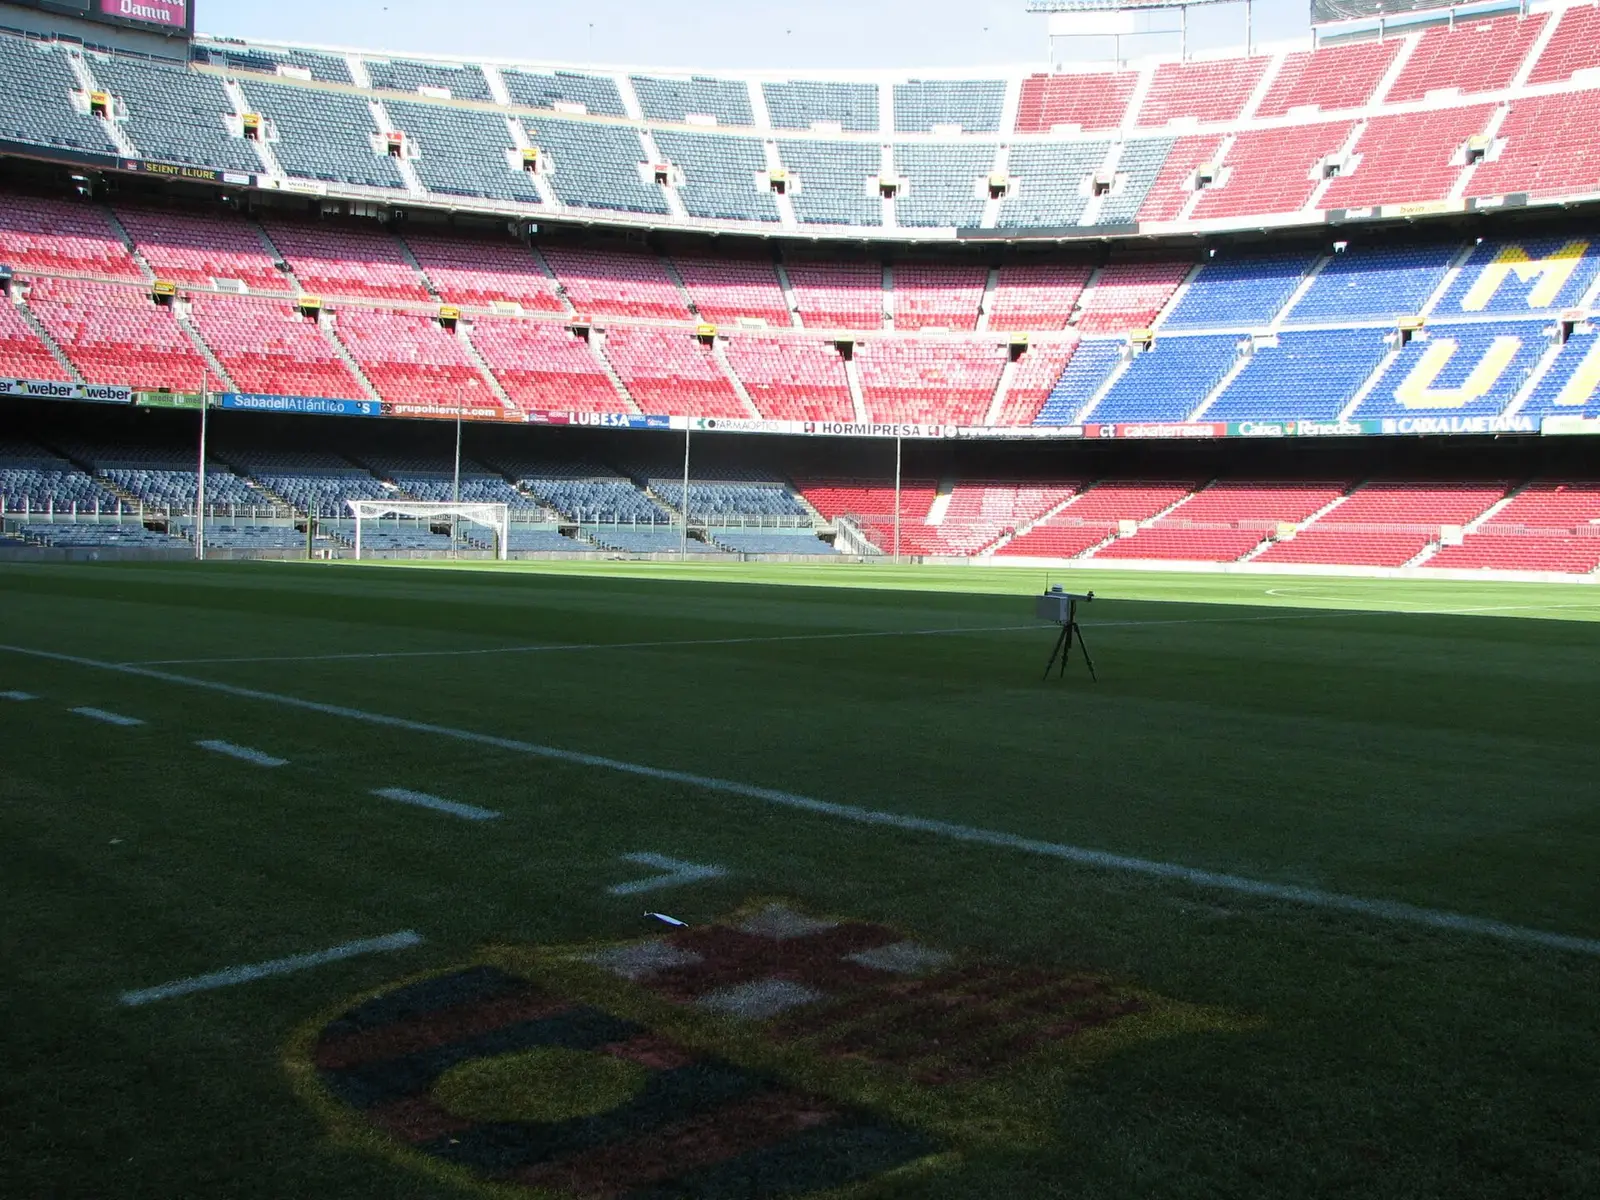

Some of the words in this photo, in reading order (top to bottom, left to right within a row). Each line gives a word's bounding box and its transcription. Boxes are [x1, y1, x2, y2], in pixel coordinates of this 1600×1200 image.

[120, 0, 171, 21] Damm
[28, 383, 73, 396] weber
[86, 386, 131, 400] weber
[569, 412, 630, 427] LUBESA
[715, 419, 780, 432] FARMAOPTICS
[823, 422, 922, 437] HORMIPRESA
